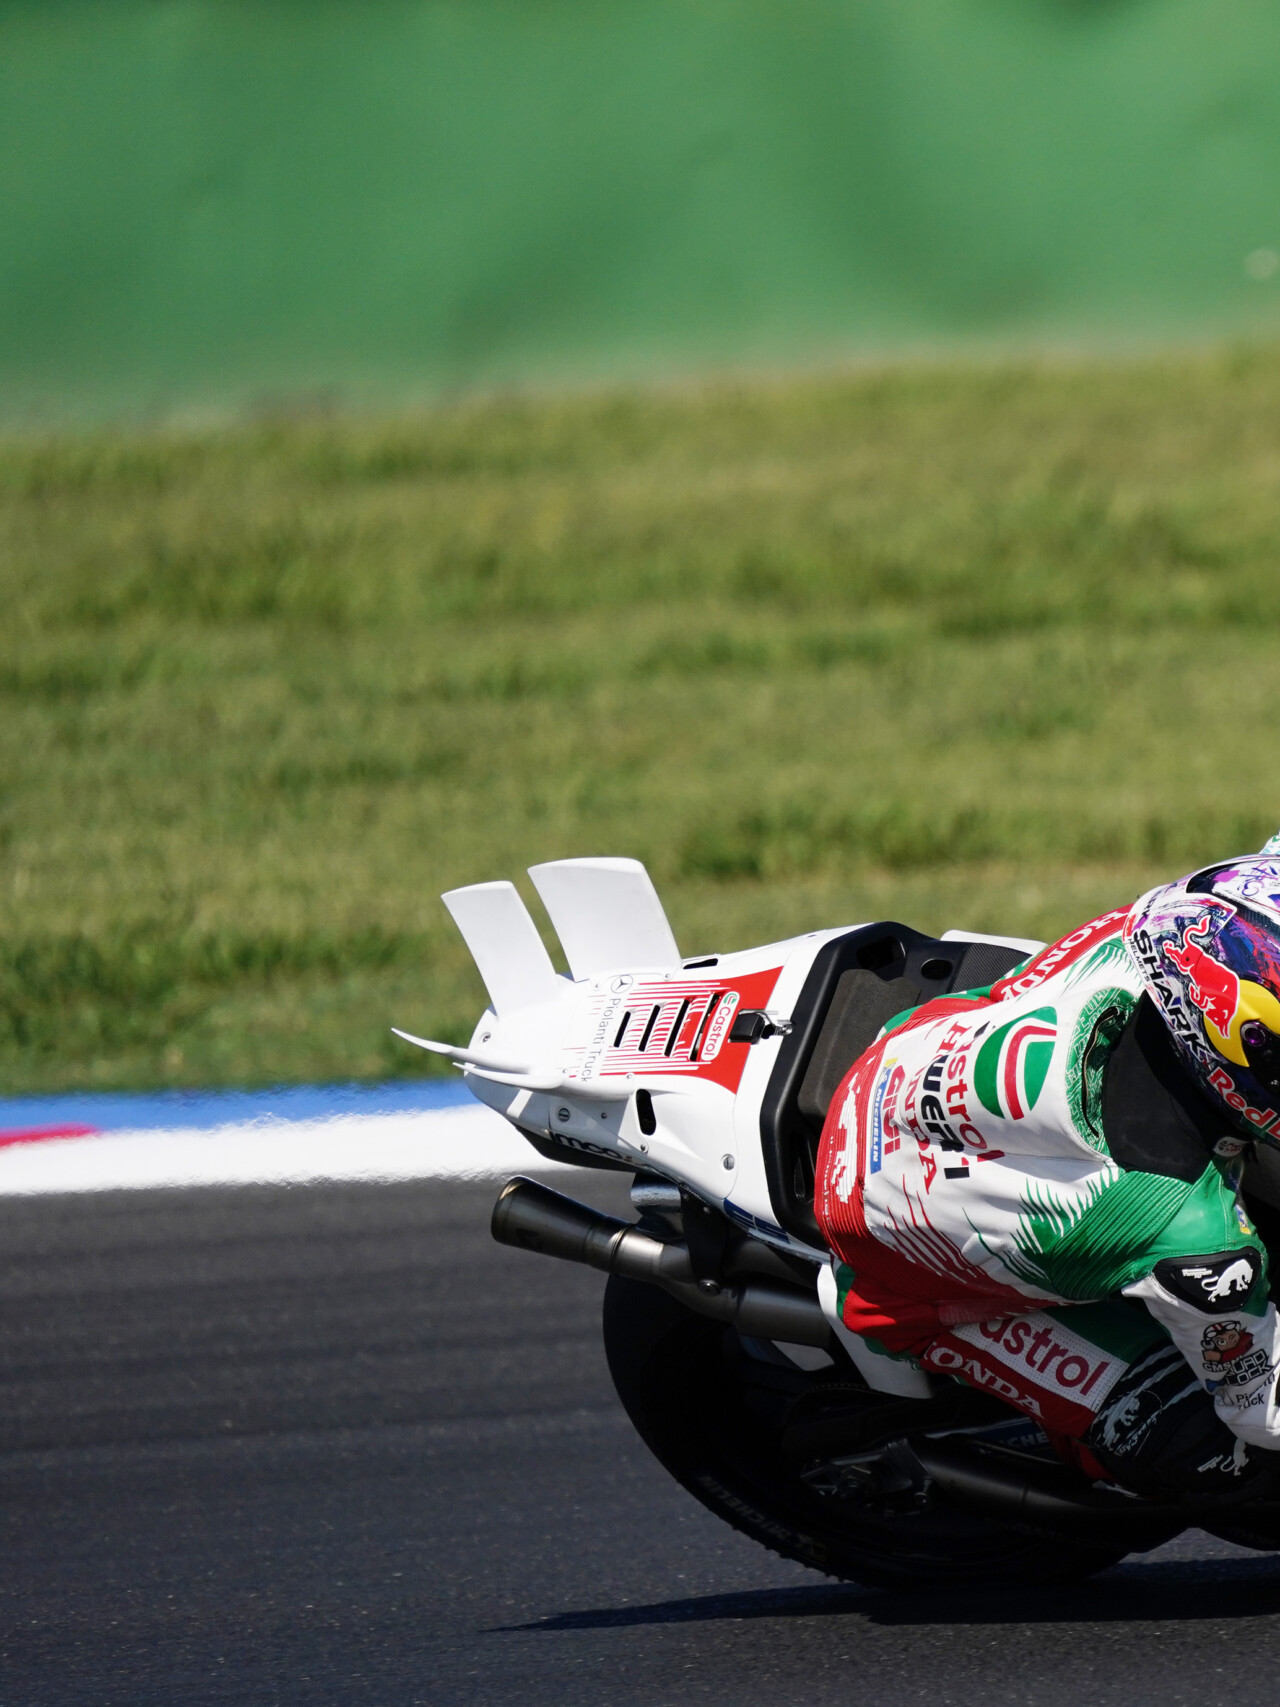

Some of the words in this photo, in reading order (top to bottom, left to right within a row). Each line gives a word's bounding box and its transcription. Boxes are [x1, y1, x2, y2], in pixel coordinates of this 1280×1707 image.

[1127, 938, 1151, 982] HELMETS
[592, 997, 622, 1046] Piolanti
[1132, 929, 1217, 1063] SHARK
[703, 1006, 731, 1056] Castrol
[581, 1049, 602, 1082] Truck
[872, 1087, 884, 1163] MICHELIN
[1207, 1066, 1278, 1128] Red
[978, 1317, 1110, 1396] astrol
